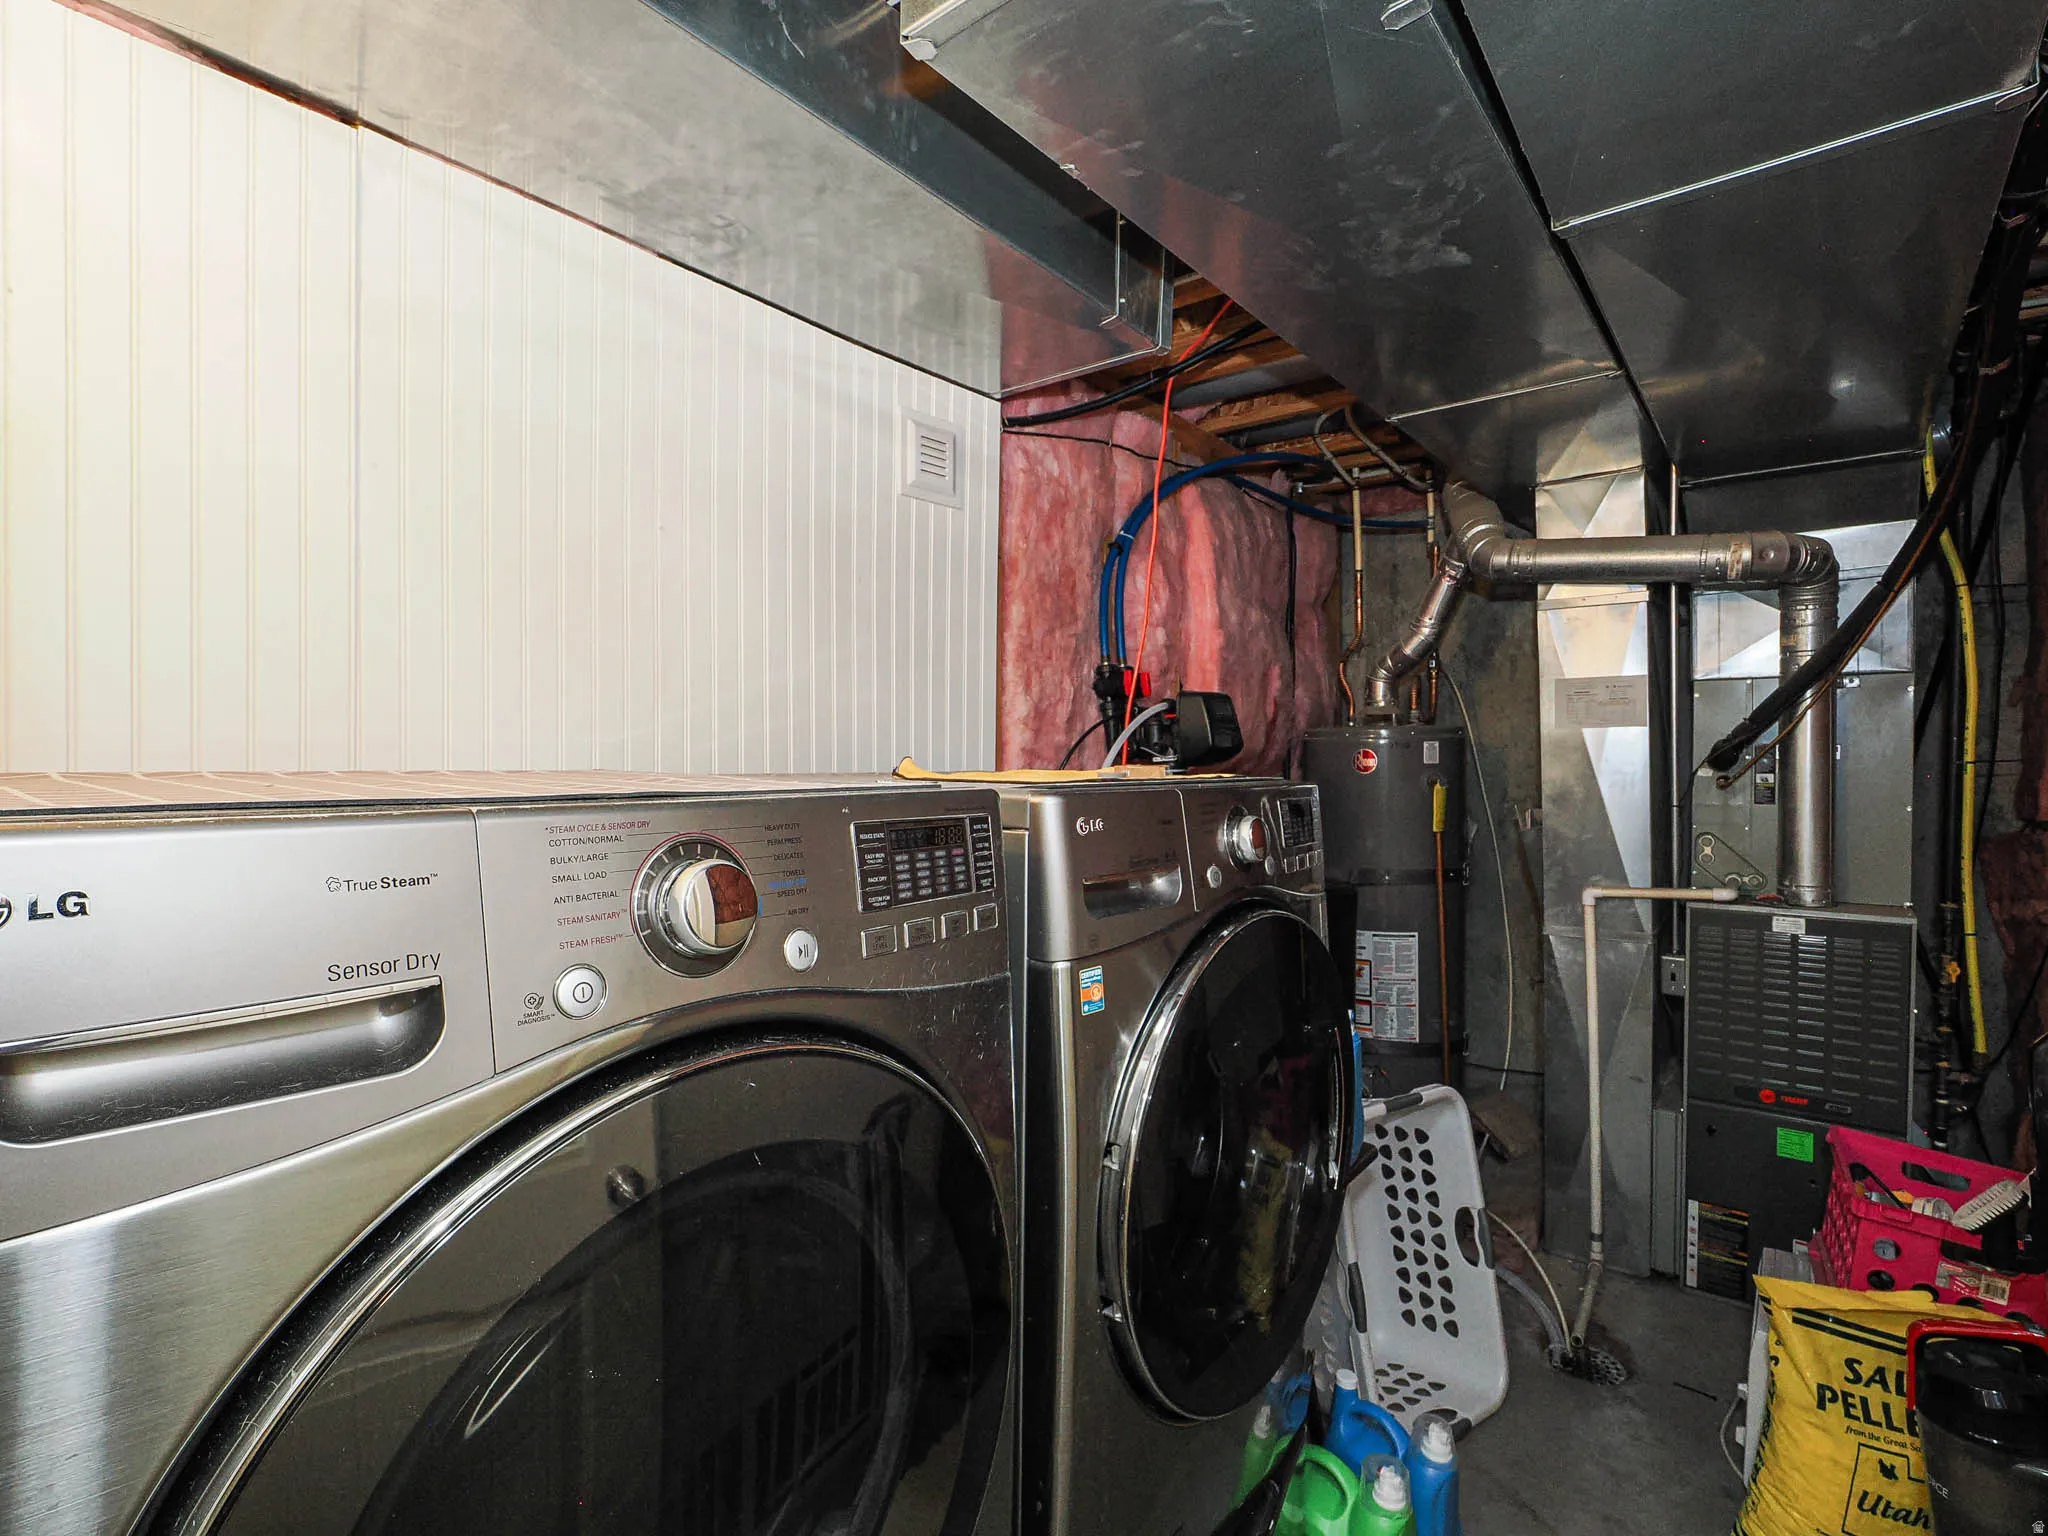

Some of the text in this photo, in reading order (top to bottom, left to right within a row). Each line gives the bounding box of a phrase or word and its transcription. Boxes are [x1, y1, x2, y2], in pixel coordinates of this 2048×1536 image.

[577, 823, 599, 832] CYCLE
[601, 823, 606, 831] &
[608, 821, 636, 830] SENSOR
[637, 820, 650, 828] DRY
[549, 835, 624, 847] COTTON/NORMAL
[550, 852, 609, 865] BULKY/LARGE
[551, 870, 607, 884] SMALL LOAD
[553, 890, 620, 905] ANTI BACTERIAL
[27, 890, 89, 921] LG
[557, 915, 584, 926] STEAM
[559, 938, 589, 950] STEAM
[327, 953, 441, 982] Sensor Dry
[523, 1010, 544, 1019] SMART
[1845, 1425, 1866, 1438] from
[1868, 1431, 1881, 1442] the
[1883, 1435, 1908, 1450] Great
[1856, 1489, 1931, 1530] Utah
